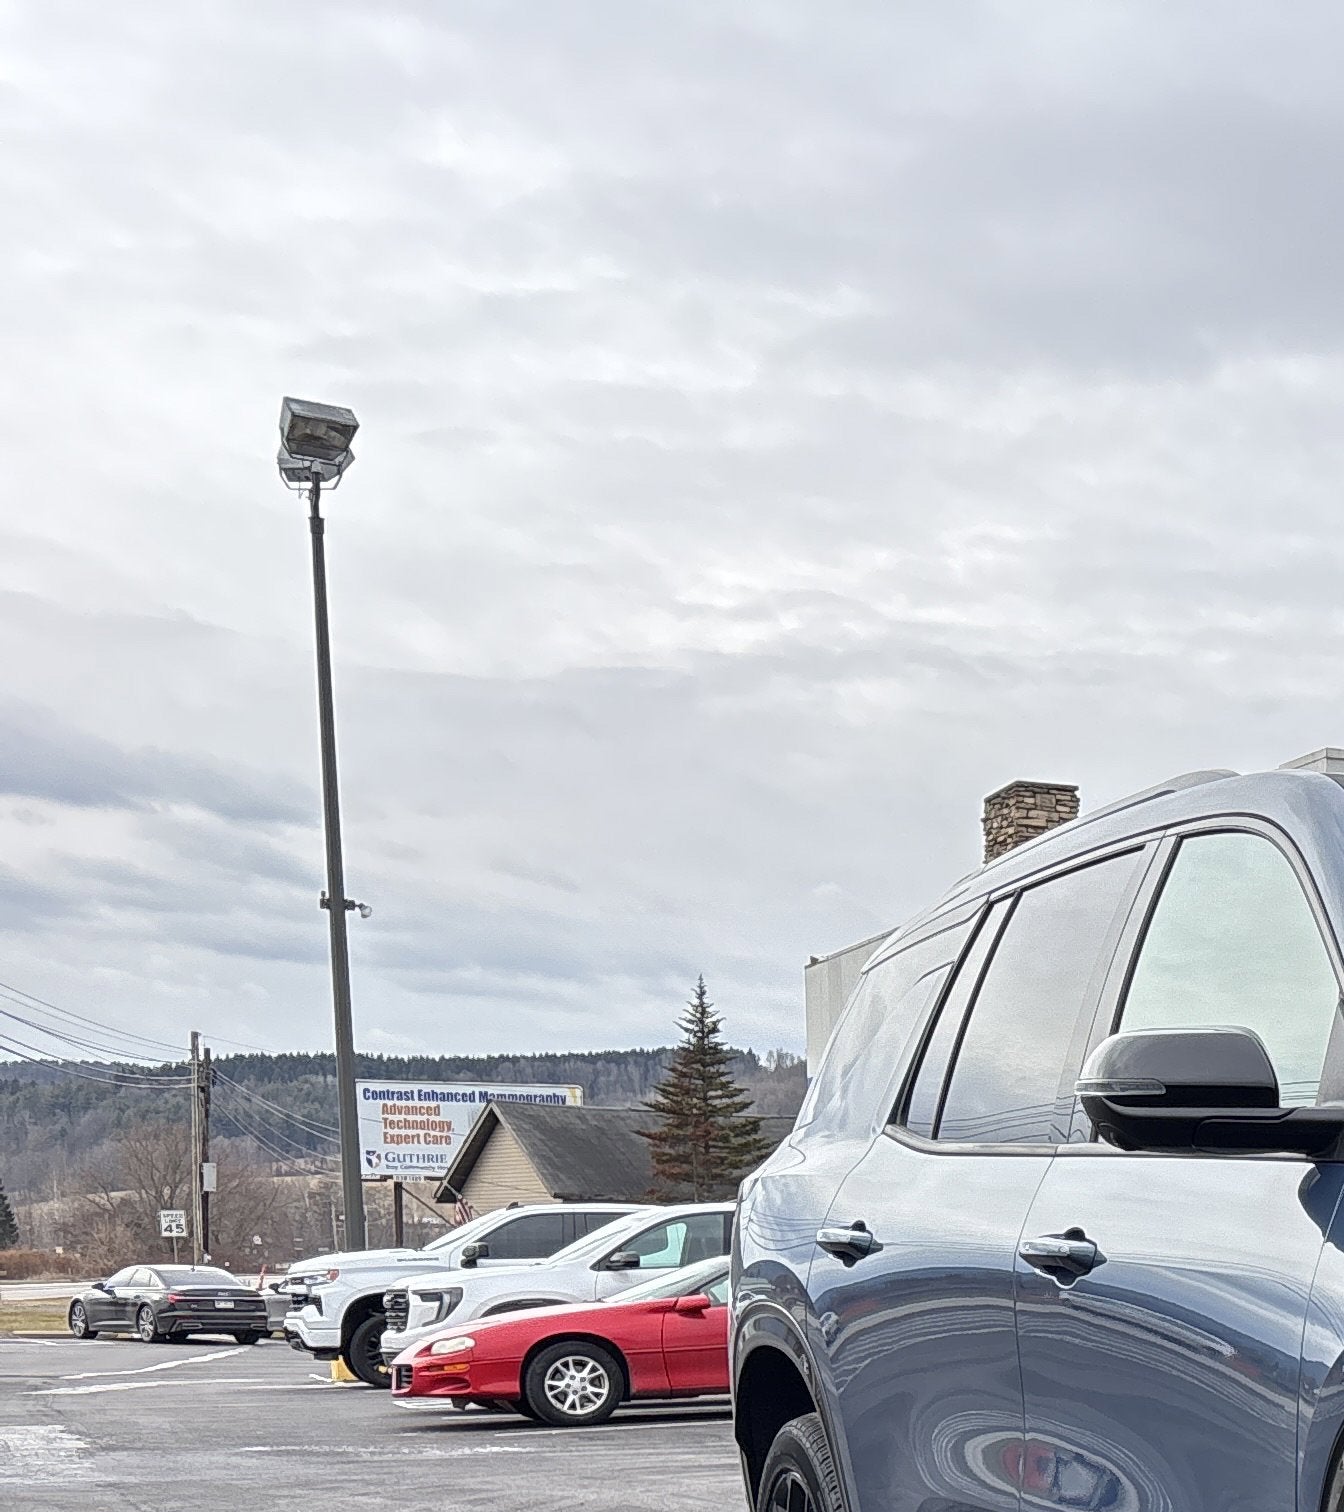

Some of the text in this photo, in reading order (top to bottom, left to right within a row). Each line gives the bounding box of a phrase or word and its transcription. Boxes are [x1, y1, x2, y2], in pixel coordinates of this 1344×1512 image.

[362, 1087, 415, 1101] Contrast
[417, 1089, 476, 1103] Enhanced
[381, 1102, 441, 1117] Advanced
[382, 1117, 455, 1133] Technology,
[383, 1131, 452, 1146] Expert Care
[384, 1151, 448, 1164] GUTHRIE
[163, 1223, 185, 1234] 45
